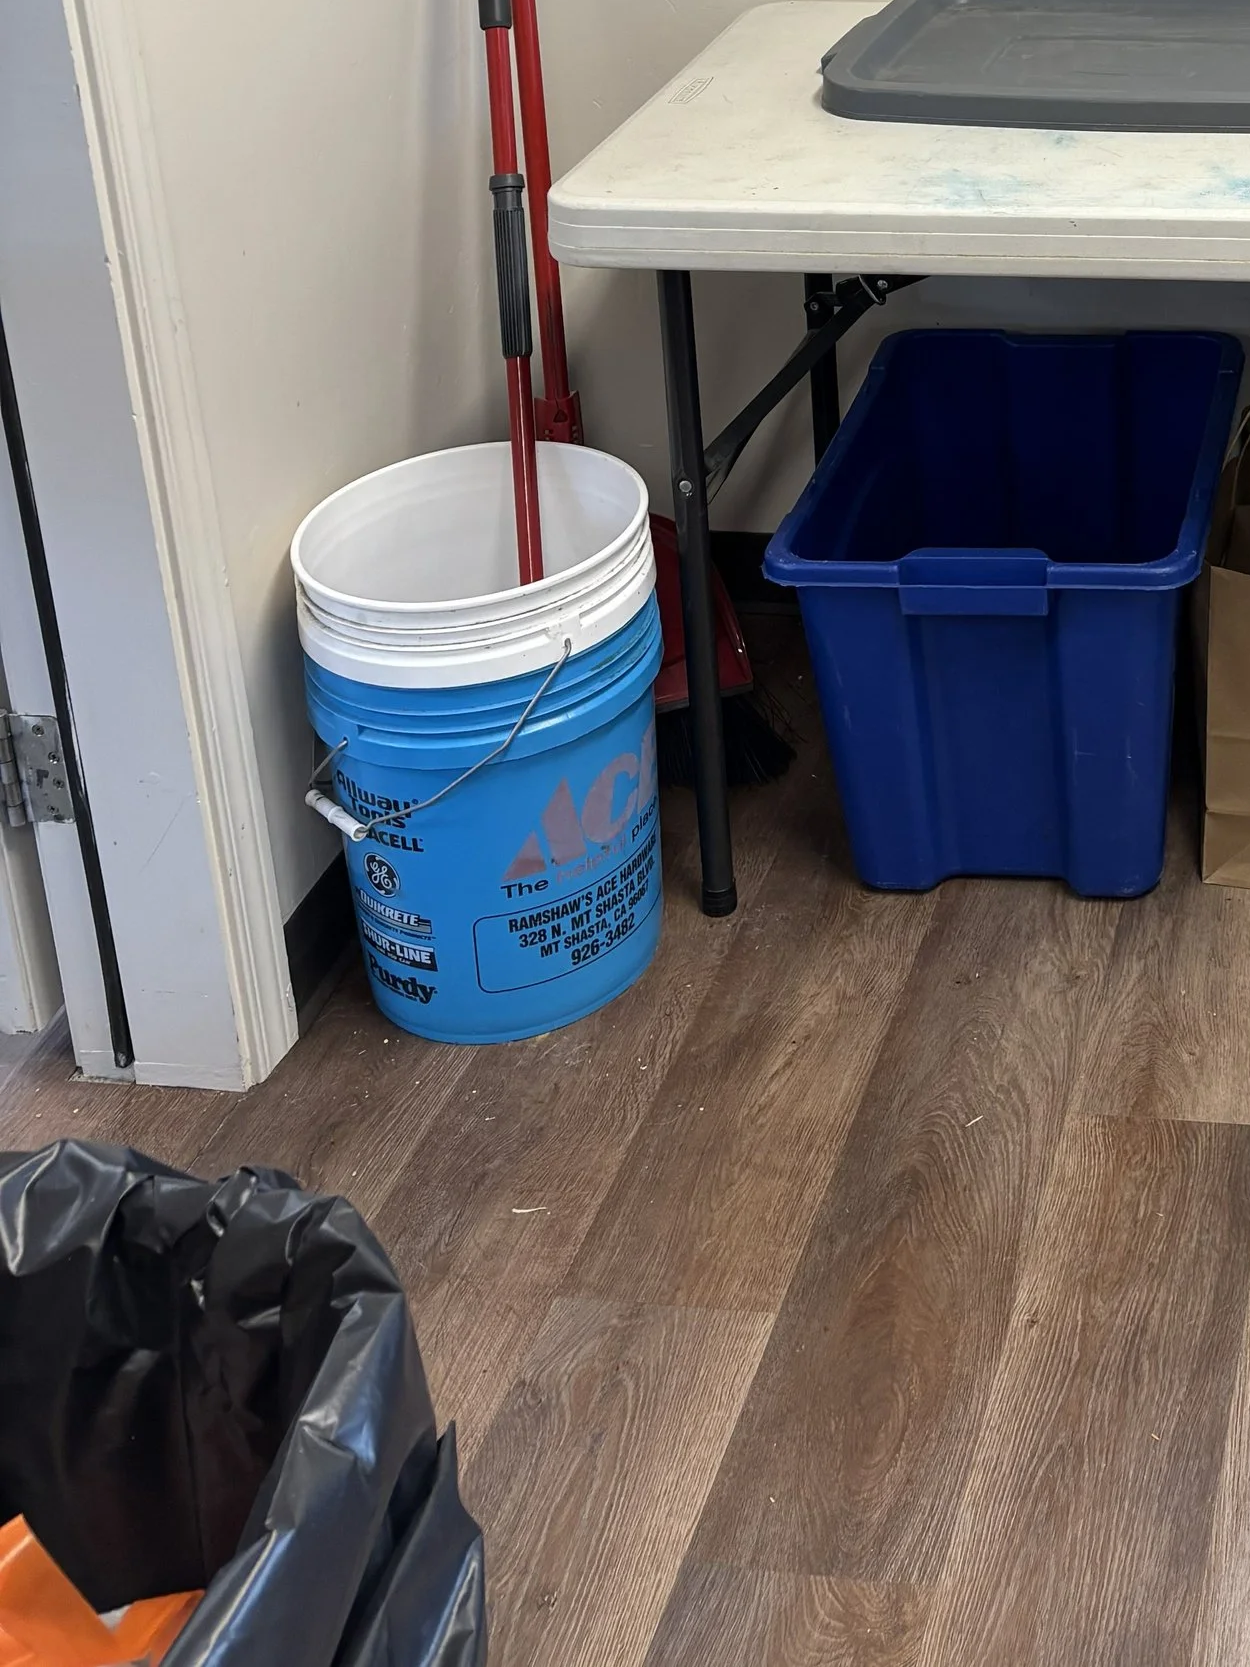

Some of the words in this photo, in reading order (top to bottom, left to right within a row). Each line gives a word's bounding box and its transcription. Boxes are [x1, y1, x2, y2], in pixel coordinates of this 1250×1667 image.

[336, 769, 412, 818] Allway
[348, 794, 406, 829] Tools
[366, 825, 424, 852] ACELL
[360, 889, 419, 926] QUIKRETE
[501, 879, 549, 899] The
[508, 892, 593, 933] RAMSHAW'S
[596, 878, 617, 902] ACE
[519, 928, 547, 949] 328
[551, 923, 566, 942] N.
[571, 914, 593, 932] MT
[595, 885, 635, 917] SHASTA
[636, 855, 655, 886] BLVD.
[540, 941, 561, 958] MT
[564, 918, 611, 949] SHASTA,
[613, 905, 626, 922] CA
[628, 880, 649, 910] 96067
[571, 912, 635, 966] 926-3482
[367, 950, 435, 1005] Purdy
